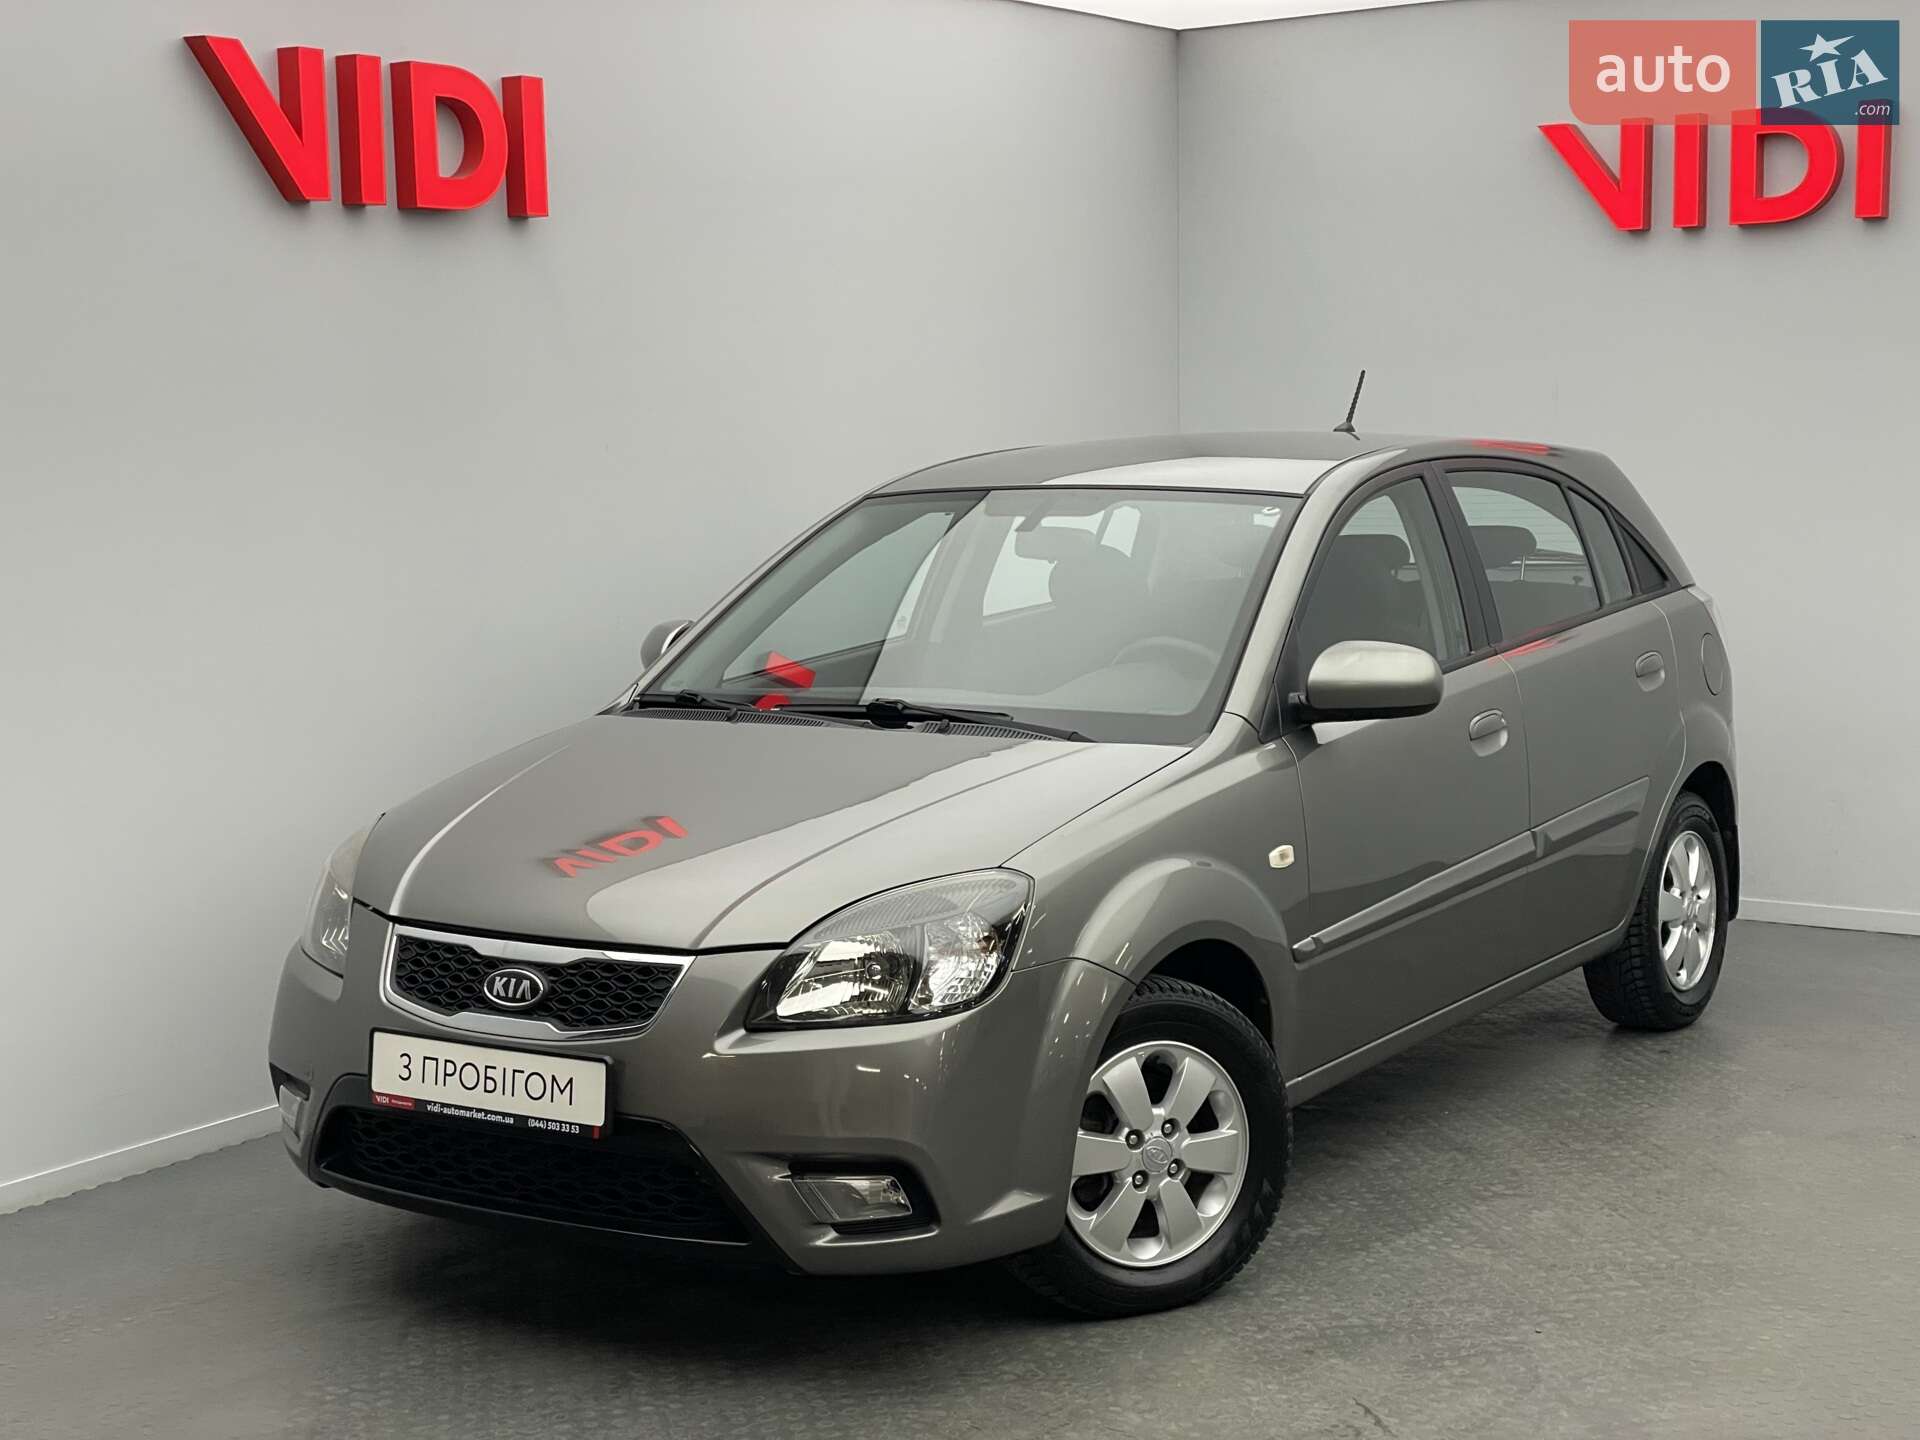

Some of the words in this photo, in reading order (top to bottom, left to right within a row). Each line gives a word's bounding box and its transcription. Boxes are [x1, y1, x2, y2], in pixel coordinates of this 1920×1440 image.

[182, 34, 550, 218] VIDI
[1537, 100, 1893, 232] VIDI
[492, 976, 532, 1001] KIA
[398, 1052, 412, 1081] З
[421, 1056, 574, 1106] ПРОБІГОМ
[375, 1095, 389, 1104] VIDI
[426, 1102, 514, 1124] vidi-automarket.com.ua
[528, 1118, 547, 1130] (044)
[547, 1121, 560, 1131] 503
[561, 1123, 570, 1133] 33
[570, 1125, 580, 1134] 53
